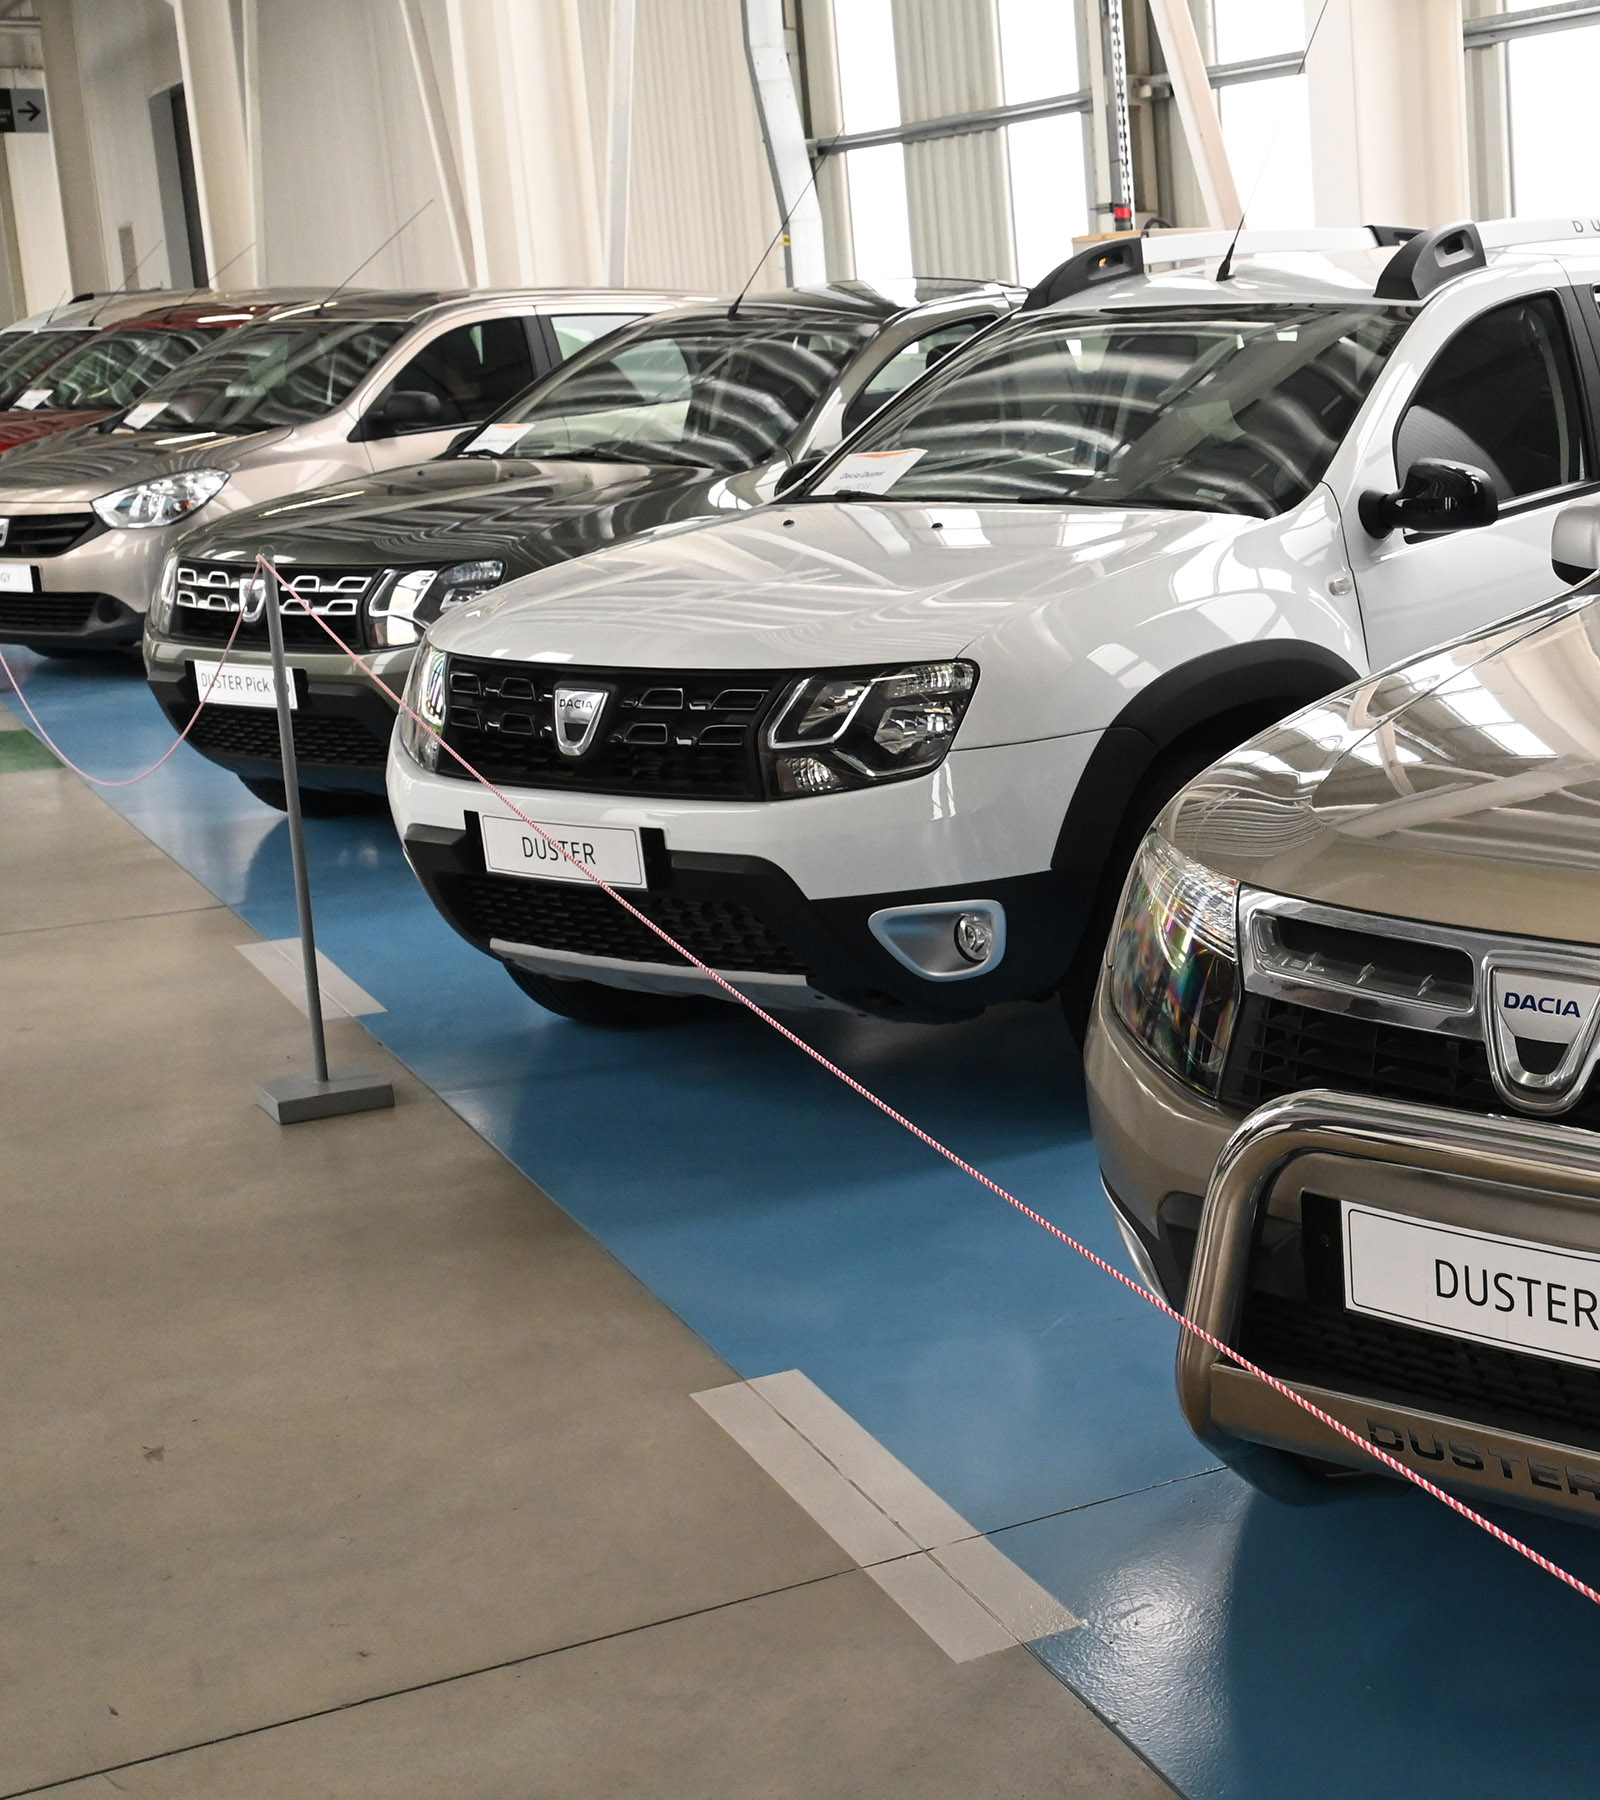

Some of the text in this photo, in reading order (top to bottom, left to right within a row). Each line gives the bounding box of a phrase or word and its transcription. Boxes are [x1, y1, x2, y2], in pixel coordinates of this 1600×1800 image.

[246, 677, 270, 692] Pick
[560, 699, 593, 710] DACIA
[522, 836, 596, 865] DUSTER
[1503, 992, 1581, 1018] DACIA
[1434, 1258, 1600, 1331] DUSTER
